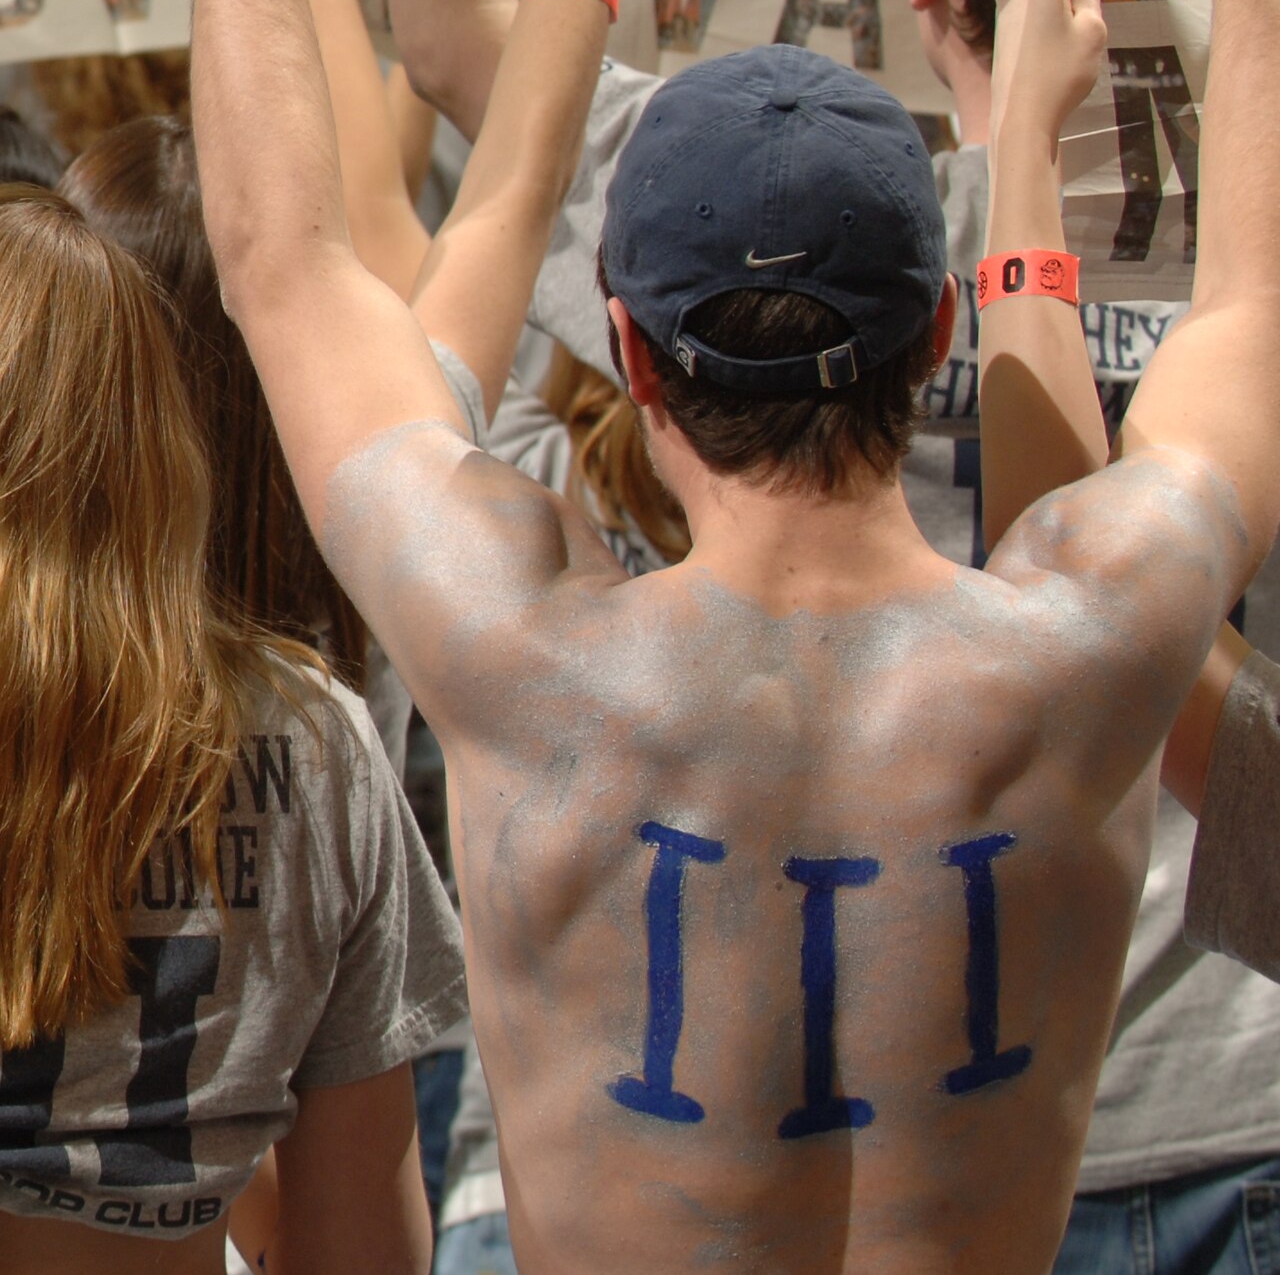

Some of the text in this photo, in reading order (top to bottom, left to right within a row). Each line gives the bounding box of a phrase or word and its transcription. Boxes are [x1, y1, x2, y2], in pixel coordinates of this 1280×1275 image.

[1079, 303, 1172, 373] HEY
[608, 820, 1032, 1139] III
[95, 1196, 222, 1229] CLUB
